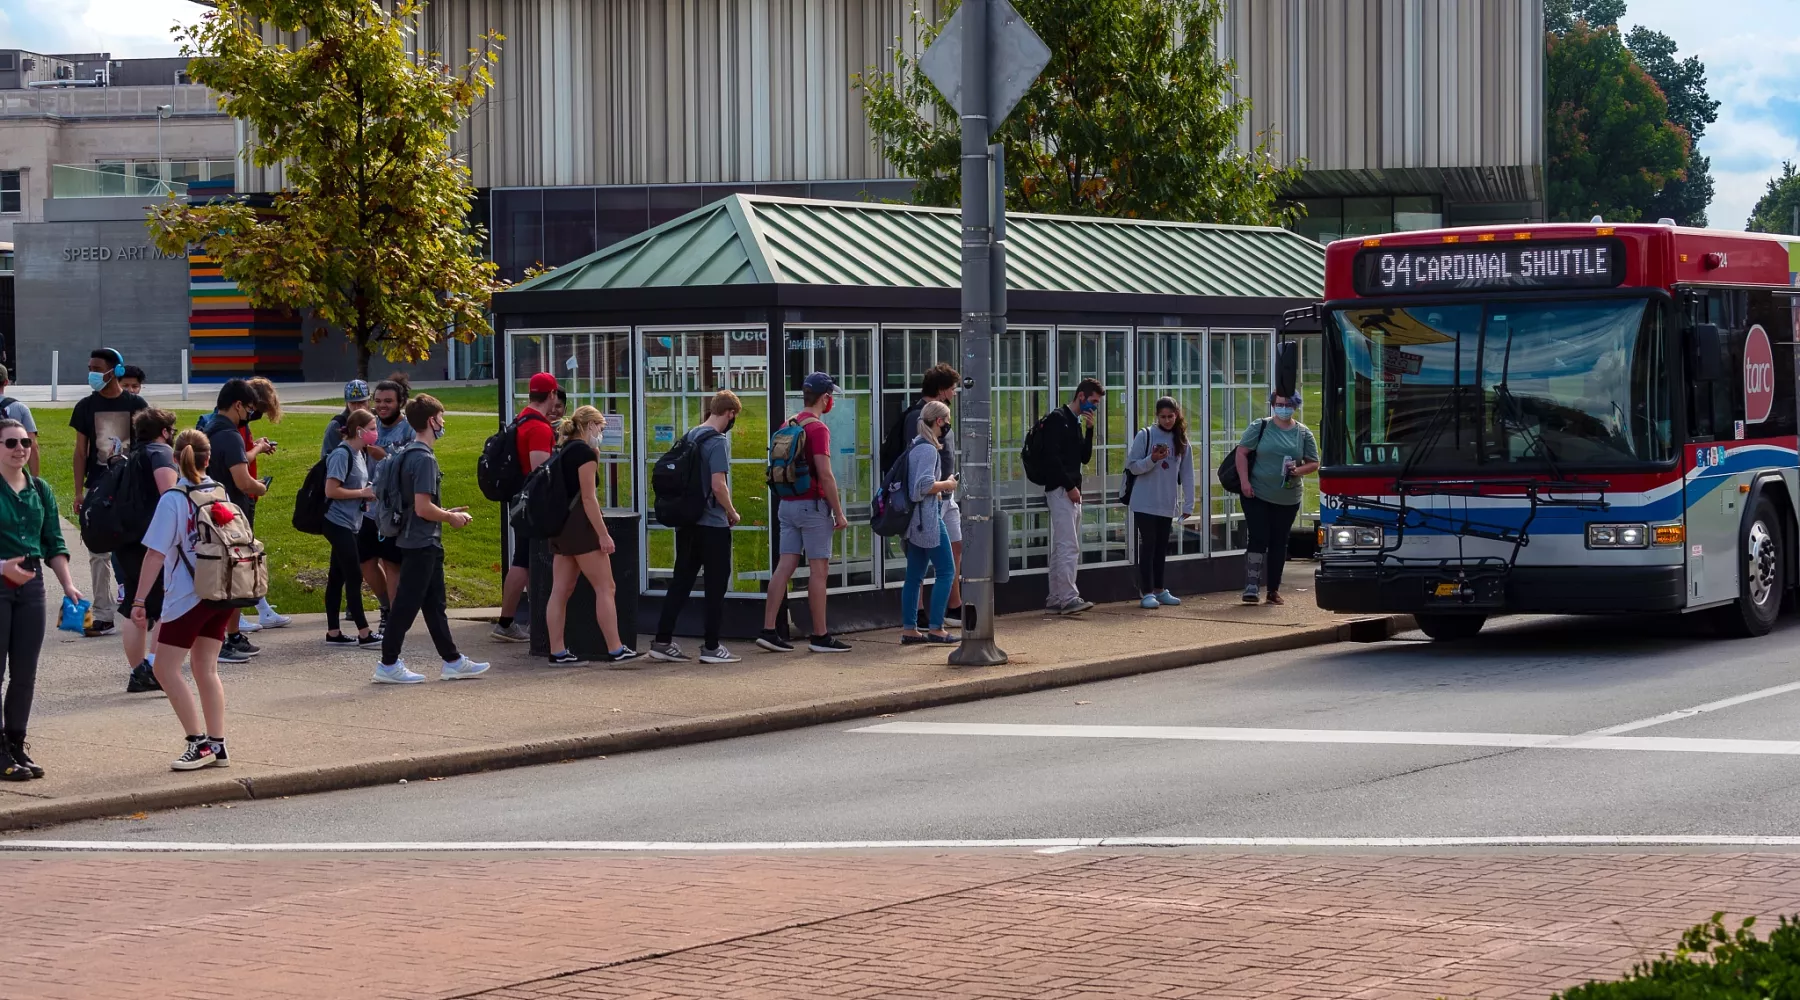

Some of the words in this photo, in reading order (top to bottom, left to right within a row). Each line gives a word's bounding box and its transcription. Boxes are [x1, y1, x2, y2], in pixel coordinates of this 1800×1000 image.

[63, 247, 112, 261] SPEED
[117, 246, 147, 260] ART
[1381, 253, 1411, 287] 94
[1415, 252, 1512, 282] CARDINAL
[1520, 247, 1607, 277] SHUTTLE
[1746, 356, 1770, 394] tarc
[1363, 446, 1399, 463] 004
